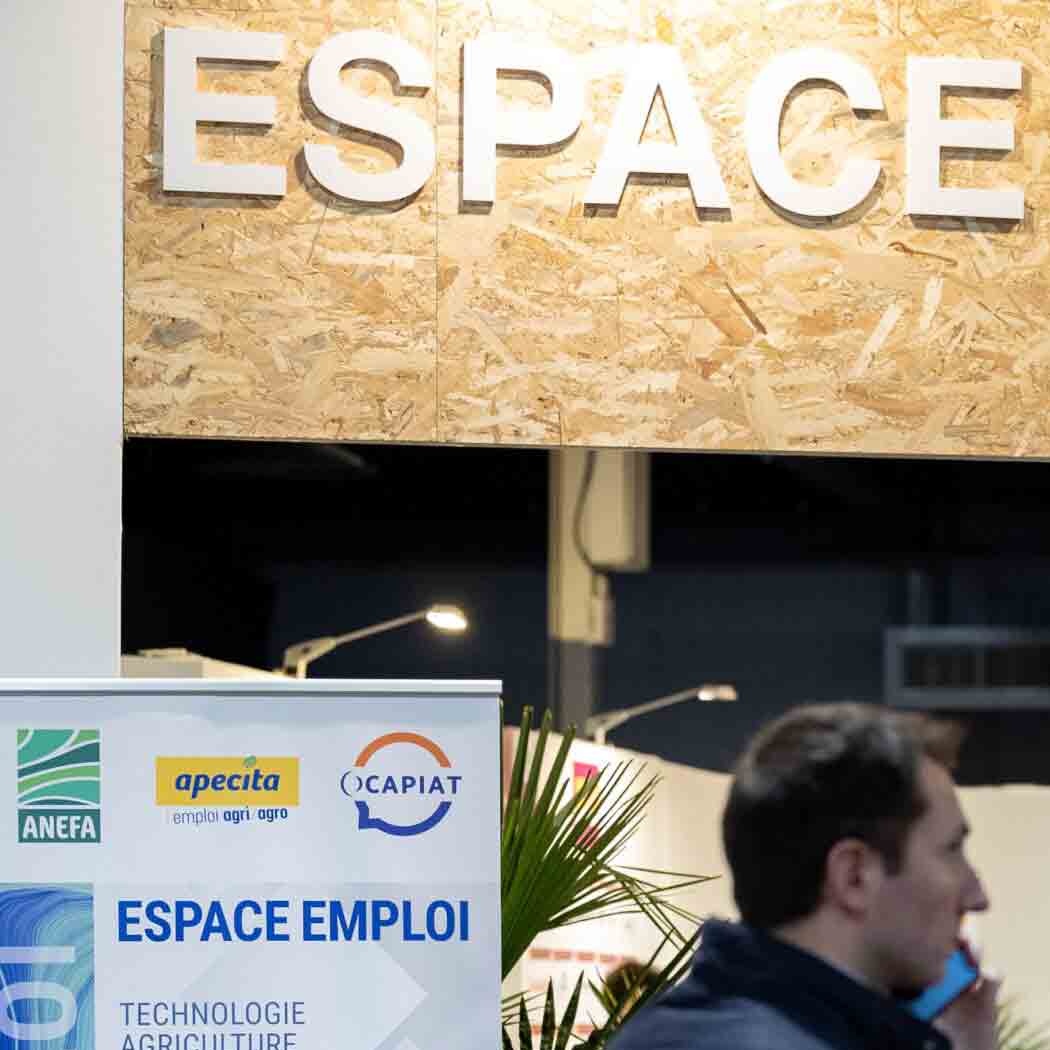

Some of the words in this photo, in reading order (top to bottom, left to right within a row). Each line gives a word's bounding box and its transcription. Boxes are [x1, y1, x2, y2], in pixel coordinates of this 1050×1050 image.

[155, 28, 1027, 228] ESPACE
[175, 765, 280, 798] apecita
[23, 814, 96, 840] ANEFA
[173, 808, 219, 825] emploi
[223, 808, 251, 822] agri
[258, 807, 288, 822] agro
[117, 900, 291, 943] ESPACE
[302, 900, 470, 941] EMPLOI
[120, 1001, 305, 1026] TECHNOLOGIE
